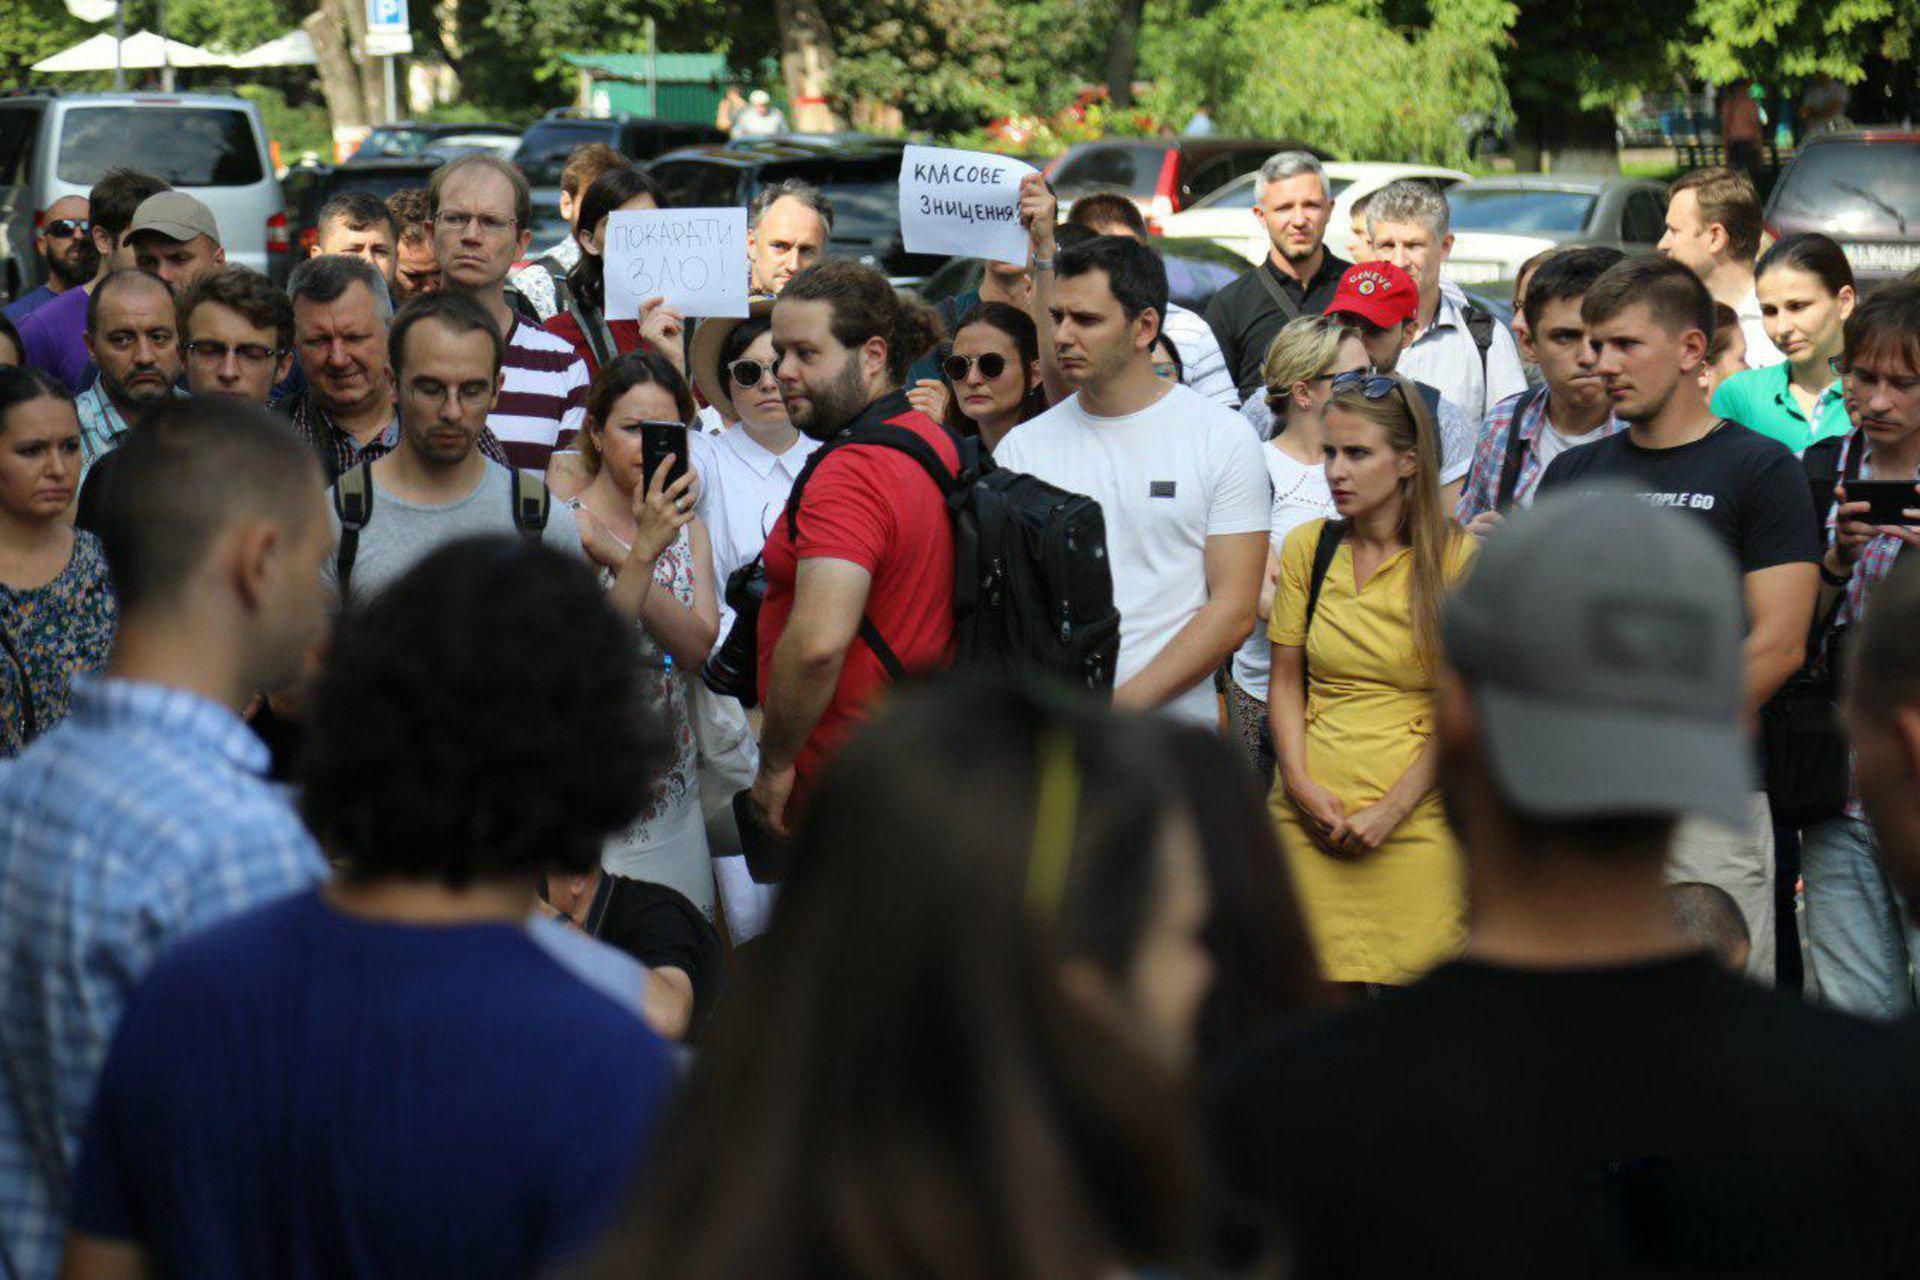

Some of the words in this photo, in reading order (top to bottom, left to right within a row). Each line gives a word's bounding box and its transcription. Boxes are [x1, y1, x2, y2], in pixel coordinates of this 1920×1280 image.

[914, 163, 1006, 185] КЛАСОВЕ
[614, 217, 733, 252] ПОКАРАТИ
[1689, 493, 1715, 511] GO
